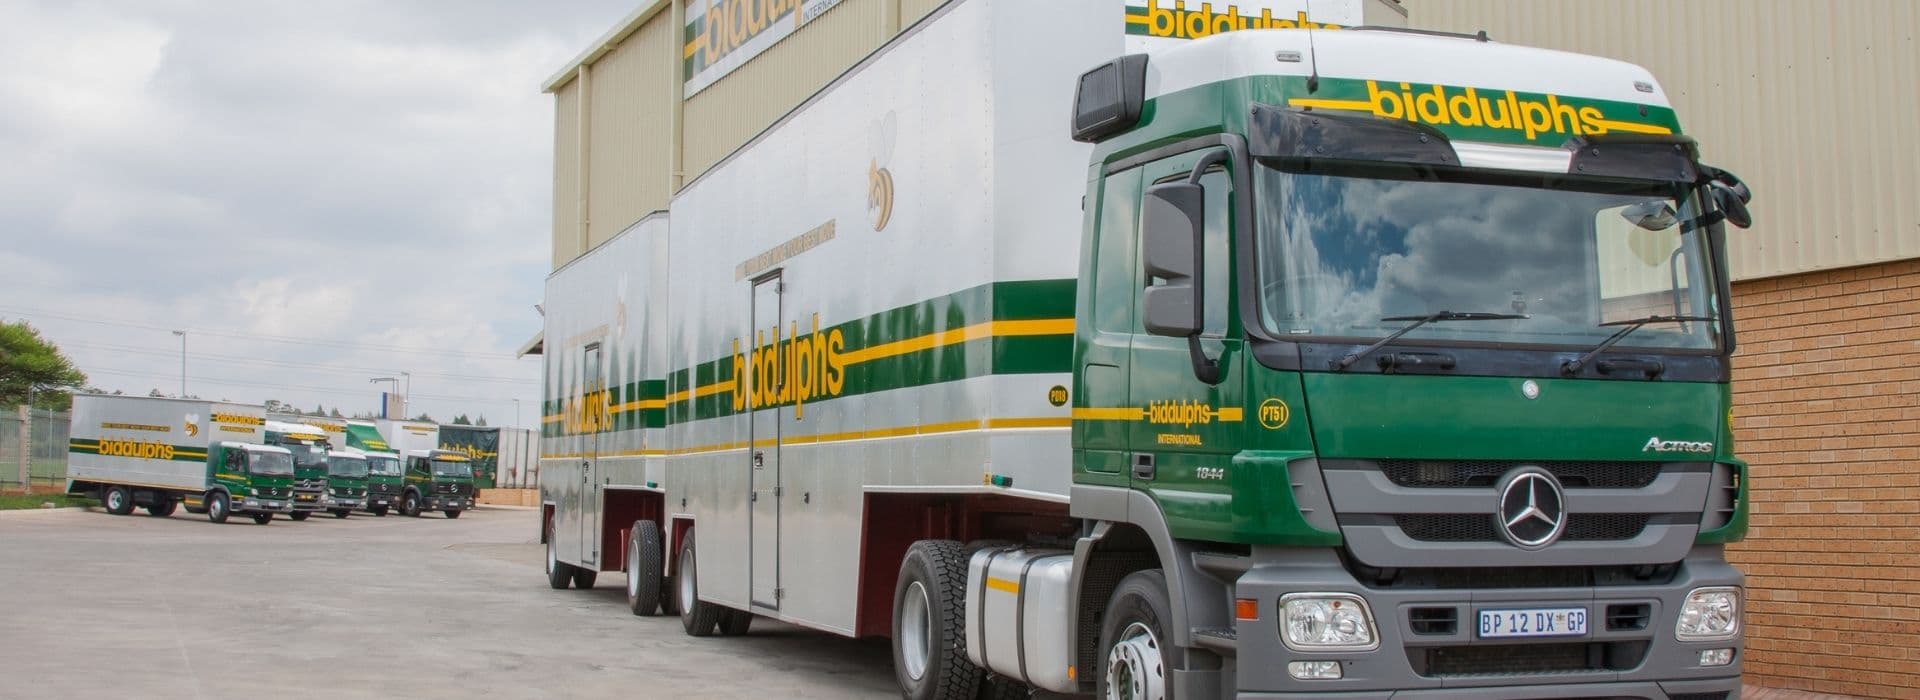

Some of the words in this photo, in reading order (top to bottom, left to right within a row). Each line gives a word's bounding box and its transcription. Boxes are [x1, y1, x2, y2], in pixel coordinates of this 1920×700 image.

[1148, 0, 1342, 39] biddul
[1366, 80, 1607, 139] biddulphs
[733, 311, 844, 420] biddulphs
[1150, 400, 1211, 428] biddulphs
[1263, 406, 1284, 421] PT51
[98, 436, 174, 461] biddulphs
[1157, 433, 1202, 445] INTERNATIONAL
[1196, 467, 1224, 480] 1844
[1482, 614, 1501, 634] BP
[1510, 613, 1528, 633] 12
[1536, 612, 1554, 632] DX
[1567, 611, 1585, 631] GP
